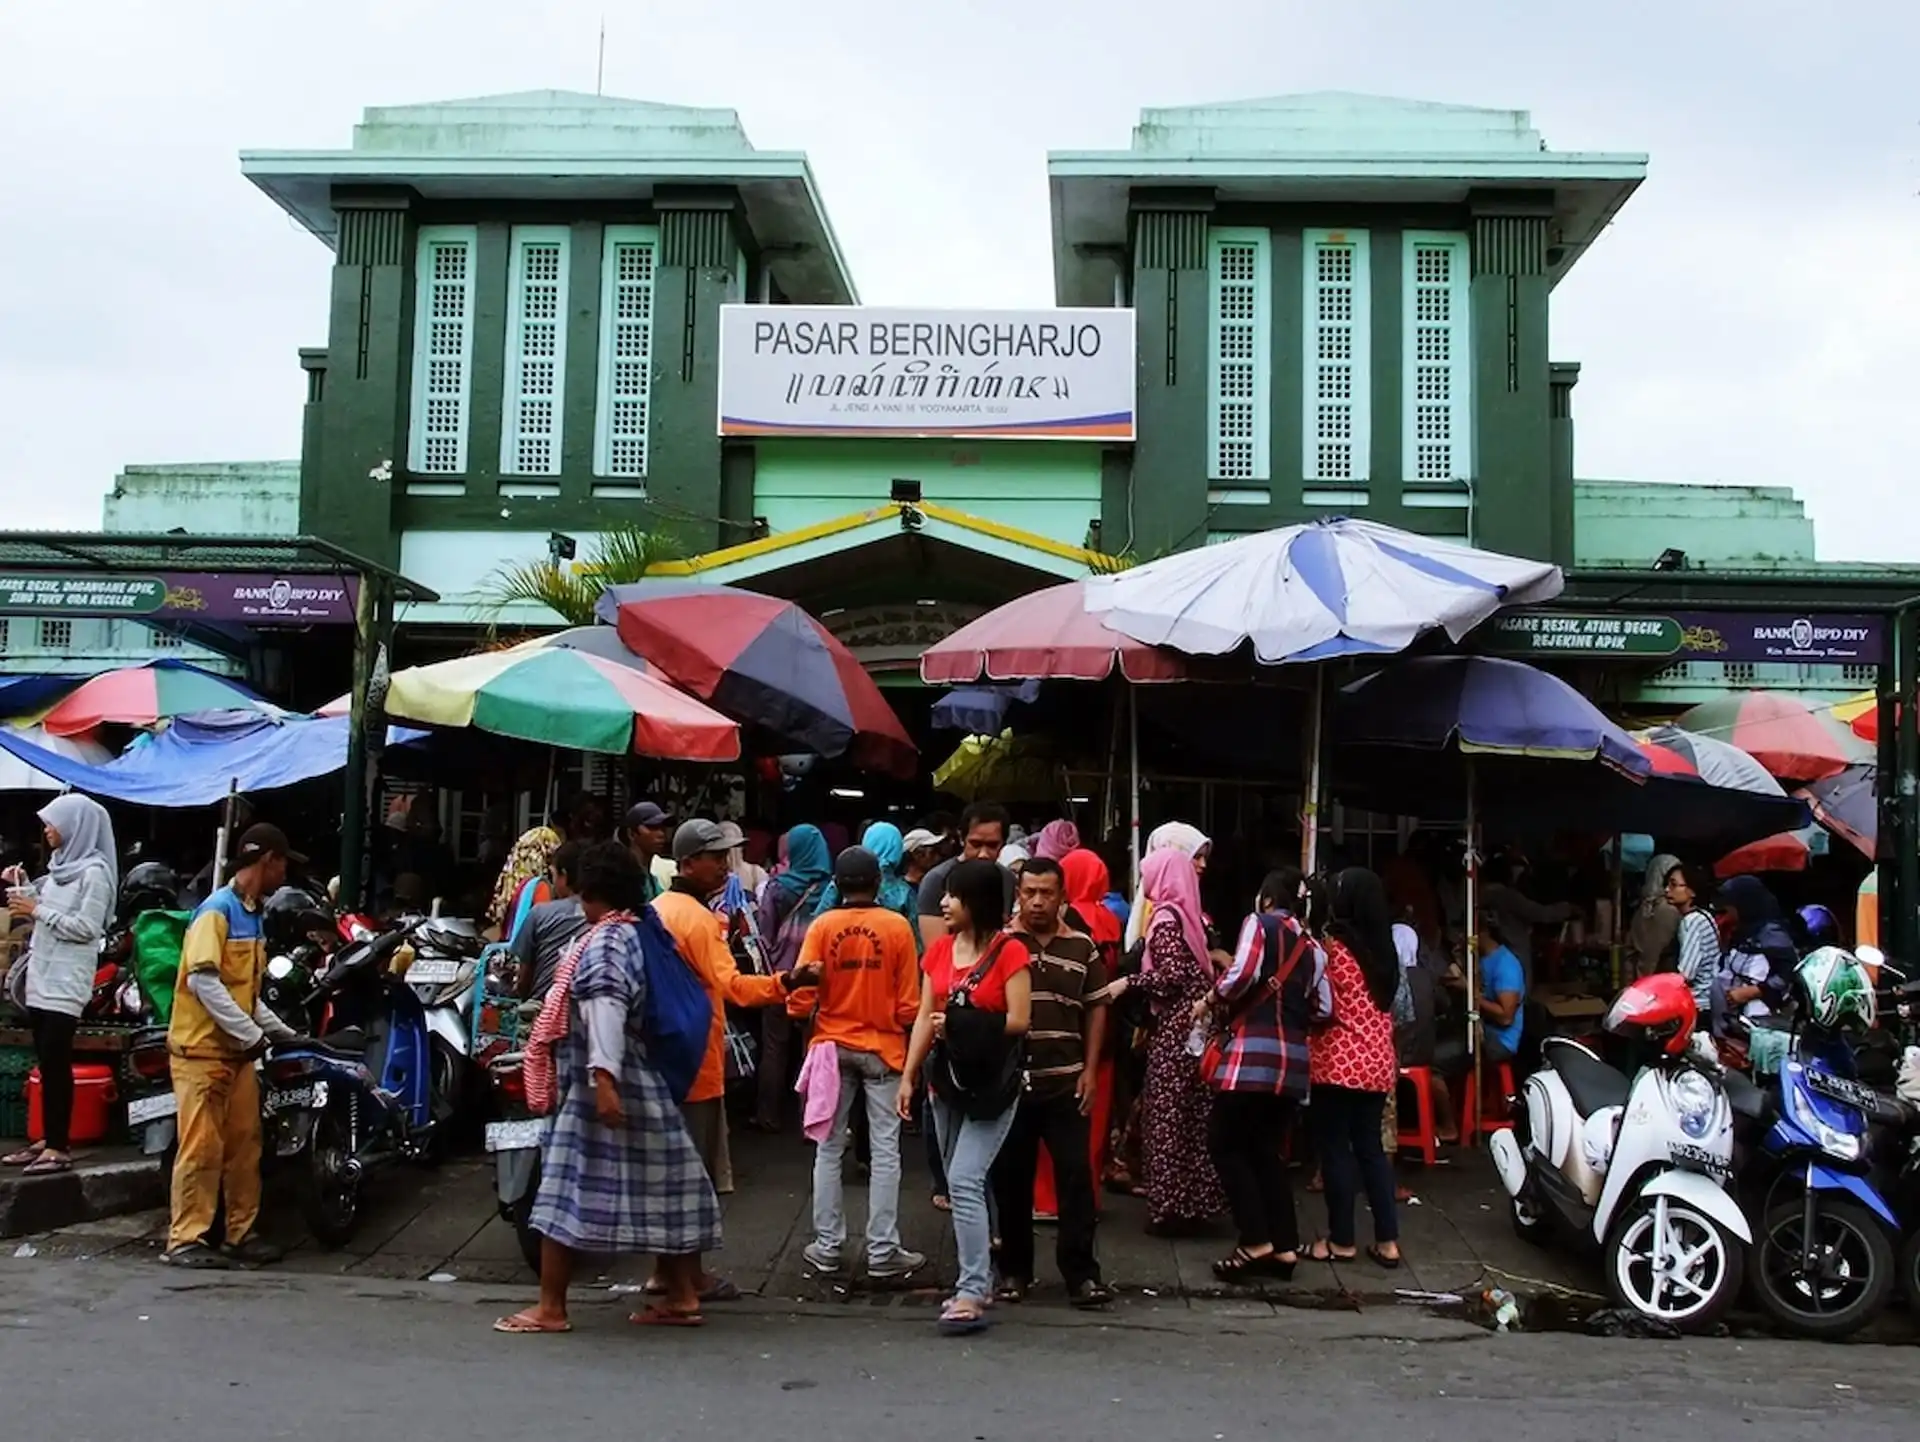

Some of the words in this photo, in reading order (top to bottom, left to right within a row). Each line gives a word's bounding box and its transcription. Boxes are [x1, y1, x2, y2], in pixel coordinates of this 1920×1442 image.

[754, 321, 859, 356] PASAR
[869, 323, 1101, 358] BERINGHARJO
[919, 403, 982, 414] YOGYAKARTA
[233, 587, 273, 599] BANK
[290, 588, 319, 600] BPD
[318, 589, 344, 601] DIY
[1541, 619, 1581, 633] RESIK,
[1583, 620, 1621, 633] ATINE
[1753, 627, 1793, 639] BANK
[1813, 628, 1842, 640] BPD
[1842, 629, 1869, 641] DIY
